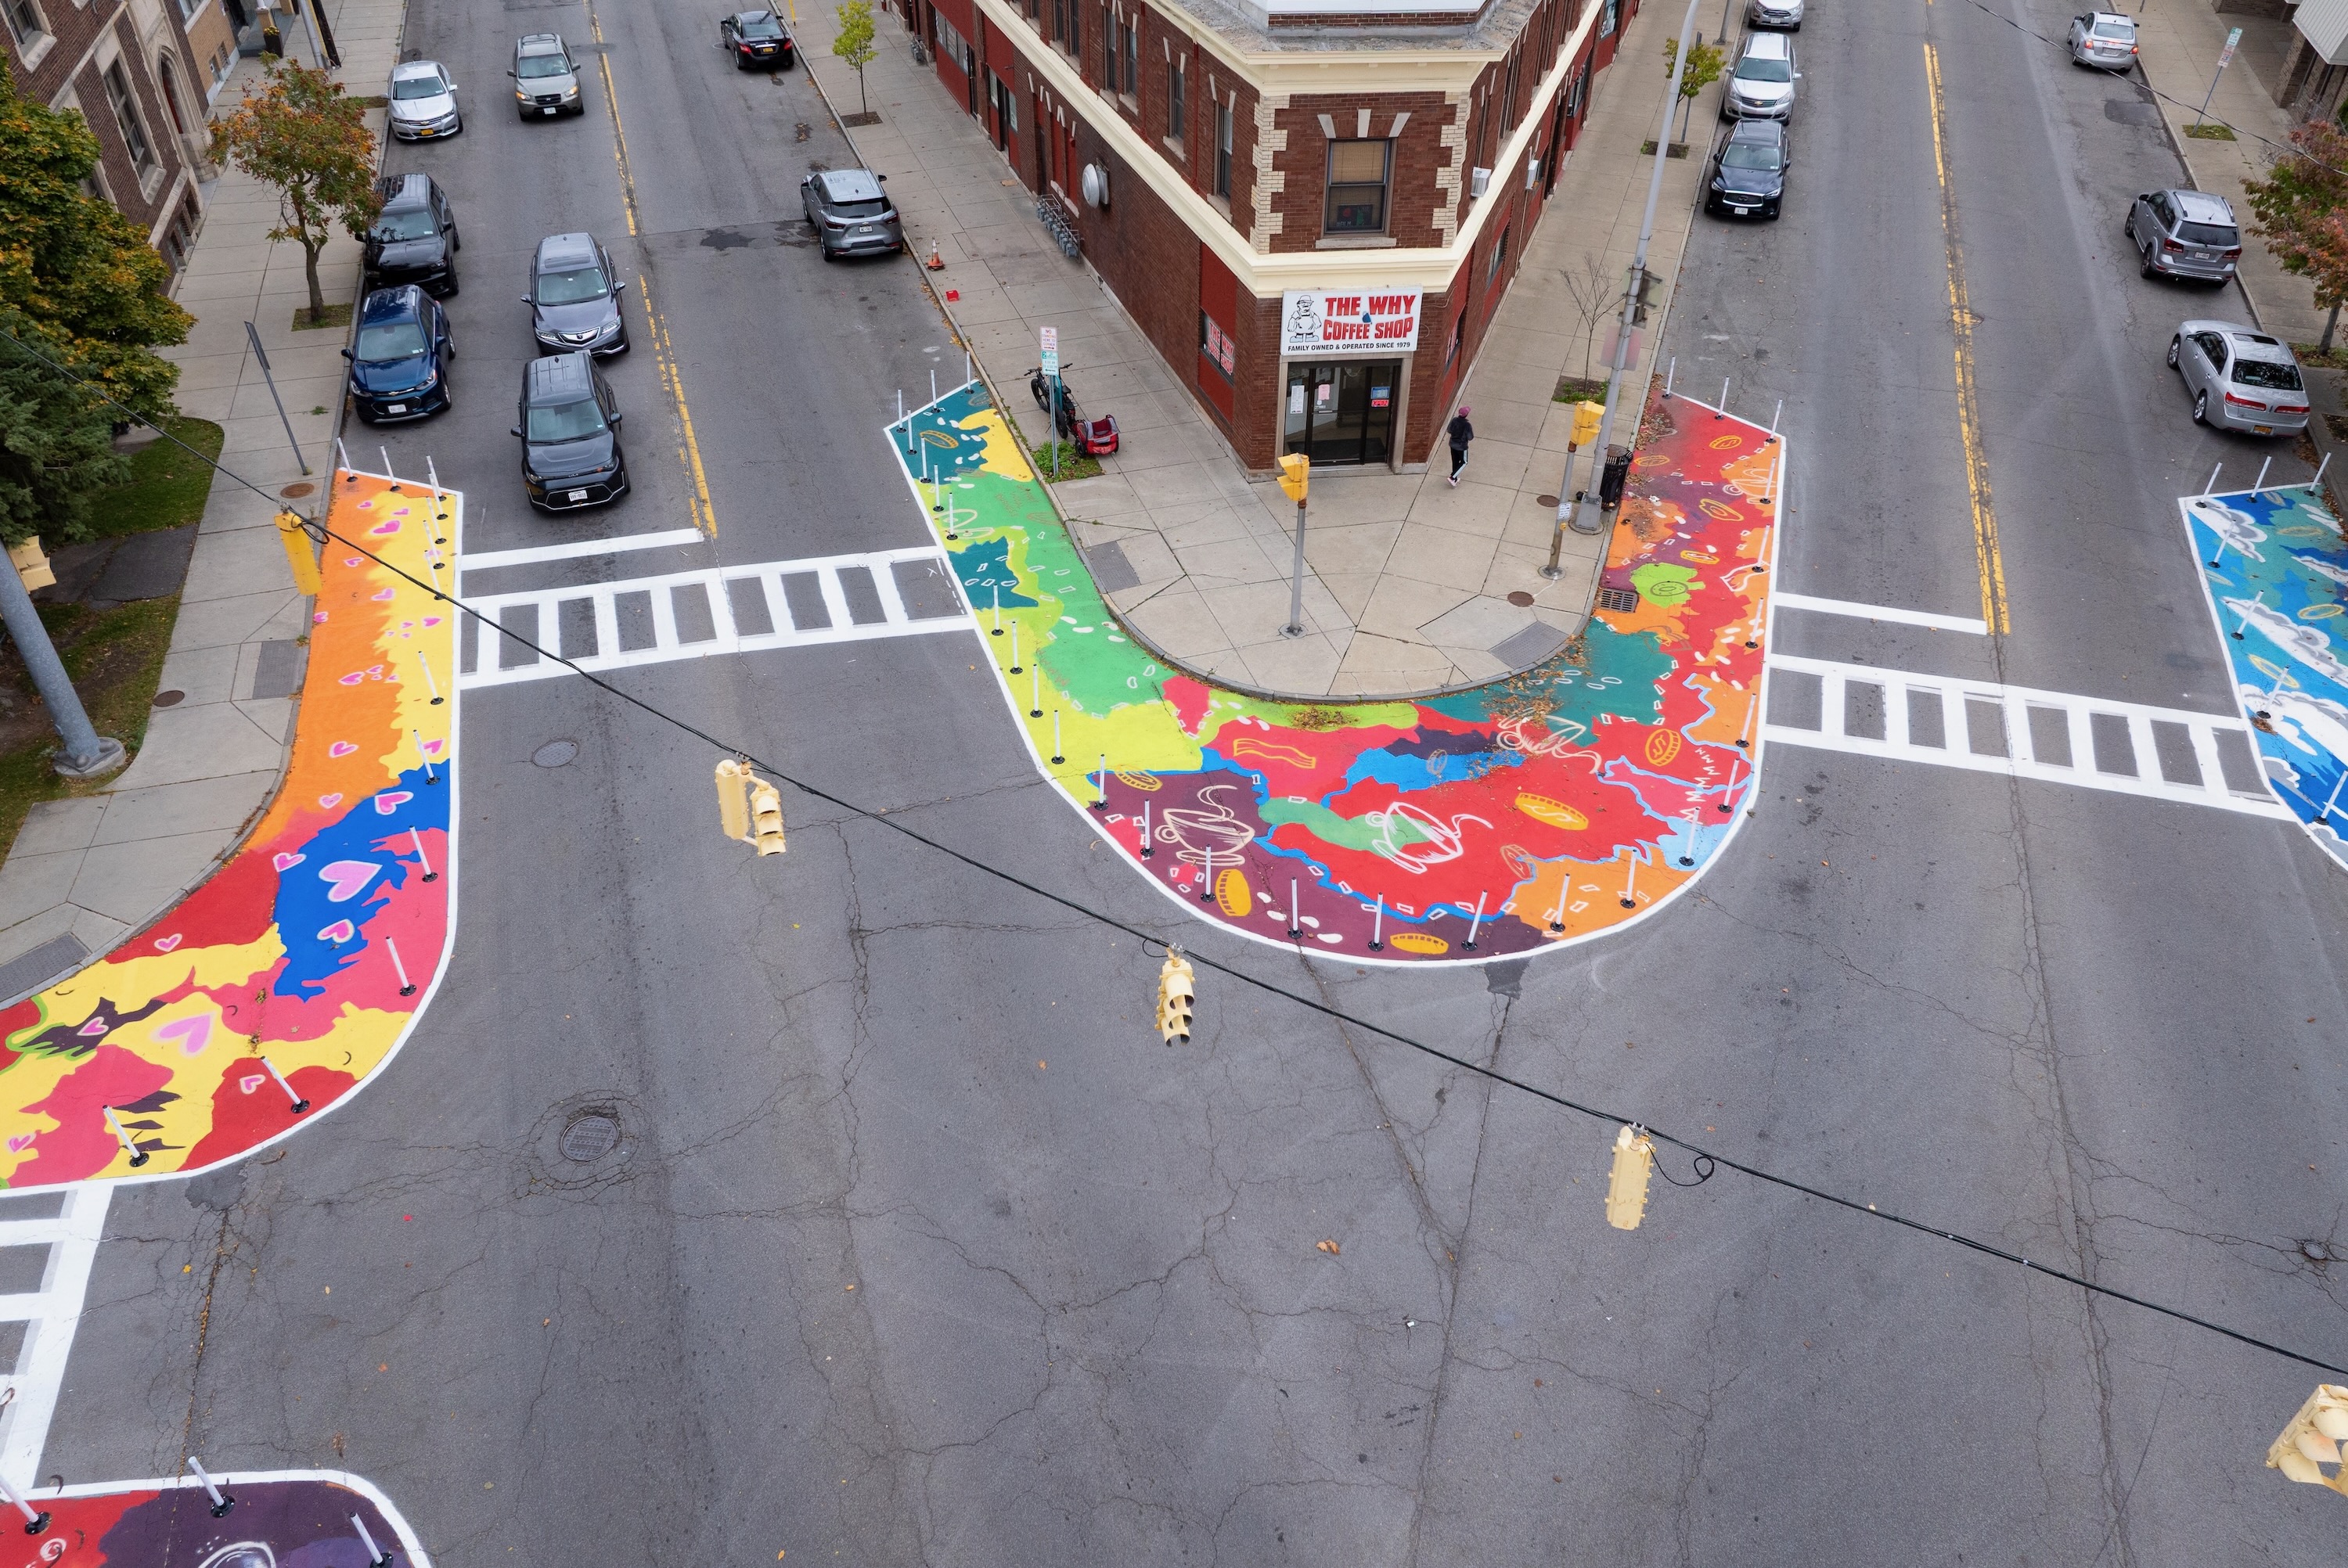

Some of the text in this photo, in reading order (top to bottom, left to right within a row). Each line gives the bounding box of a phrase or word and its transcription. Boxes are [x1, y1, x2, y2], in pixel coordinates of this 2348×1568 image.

[1325, 294, 1416, 316] THE WHY
[1209, 321, 1233, 359] THE WHY
[1323, 317, 1413, 340] COFFEE SHOP
